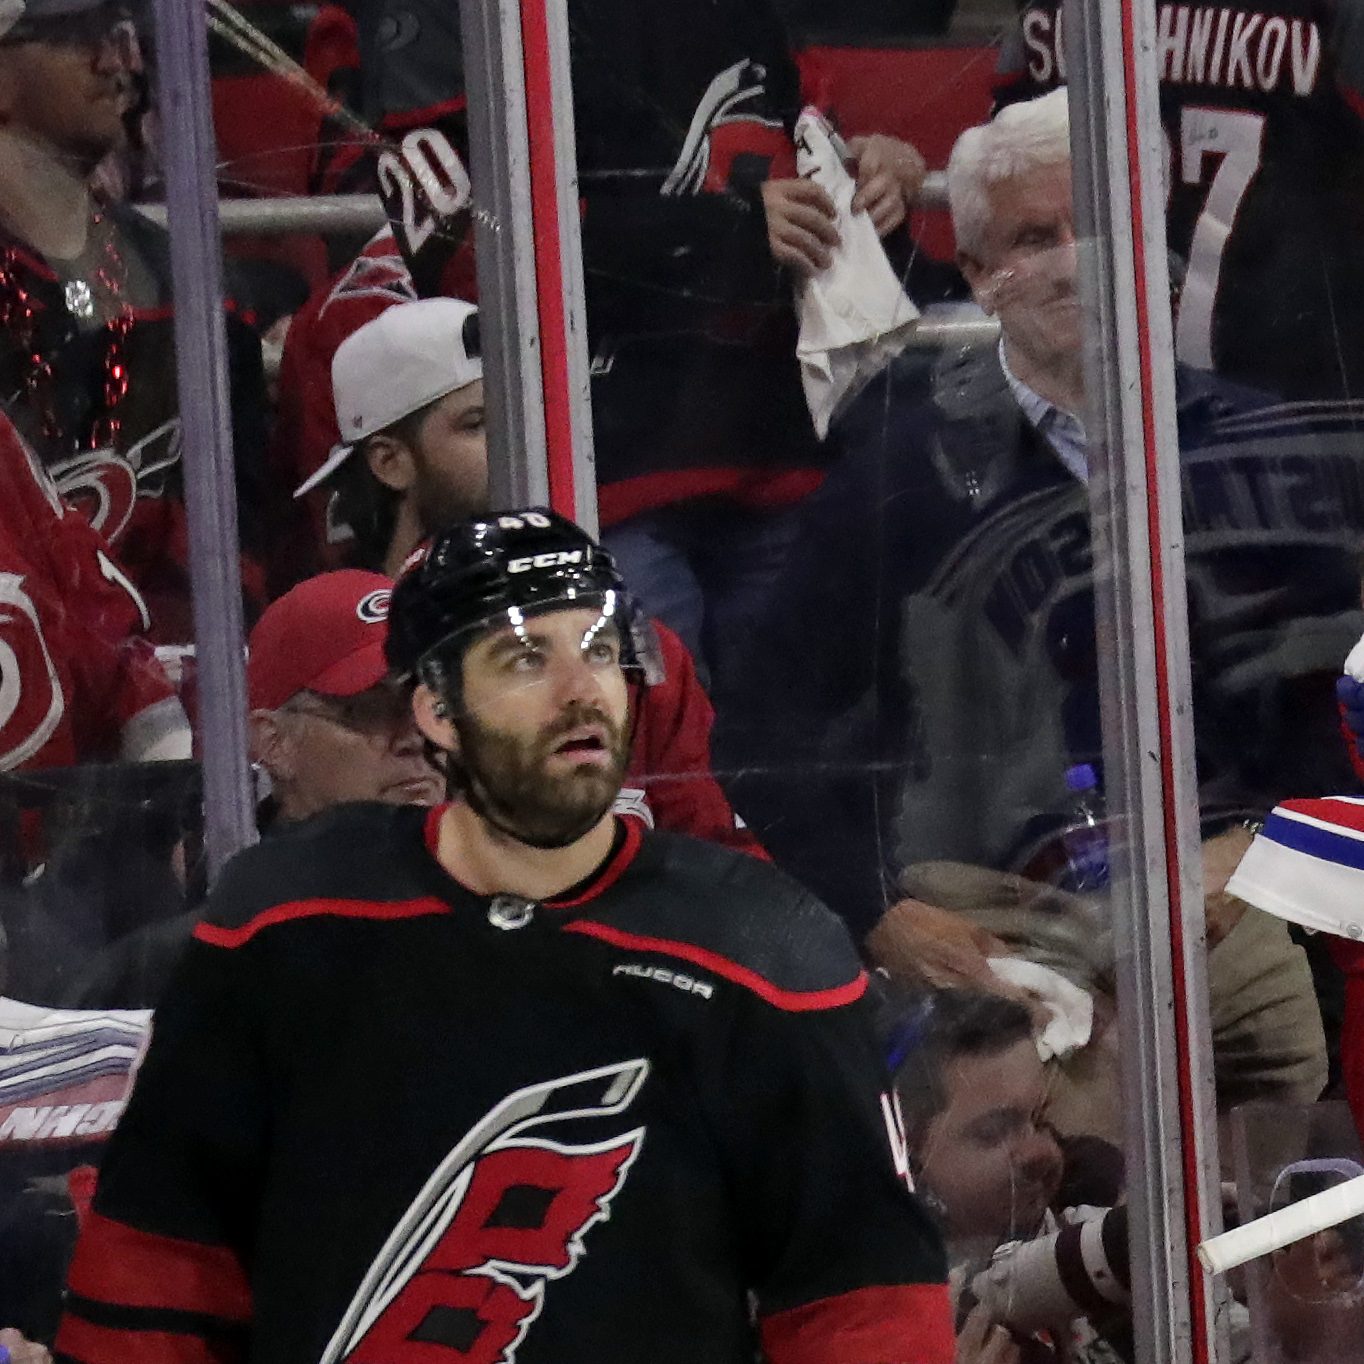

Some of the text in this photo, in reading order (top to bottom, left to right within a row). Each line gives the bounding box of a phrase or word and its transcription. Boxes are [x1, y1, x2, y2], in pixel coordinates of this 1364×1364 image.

[1023, 4, 1320, 97] SHNIKOV
[377, 128, 471, 256] 20
[1177, 105, 1266, 370] 7
[507, 550, 583, 574] CCM
